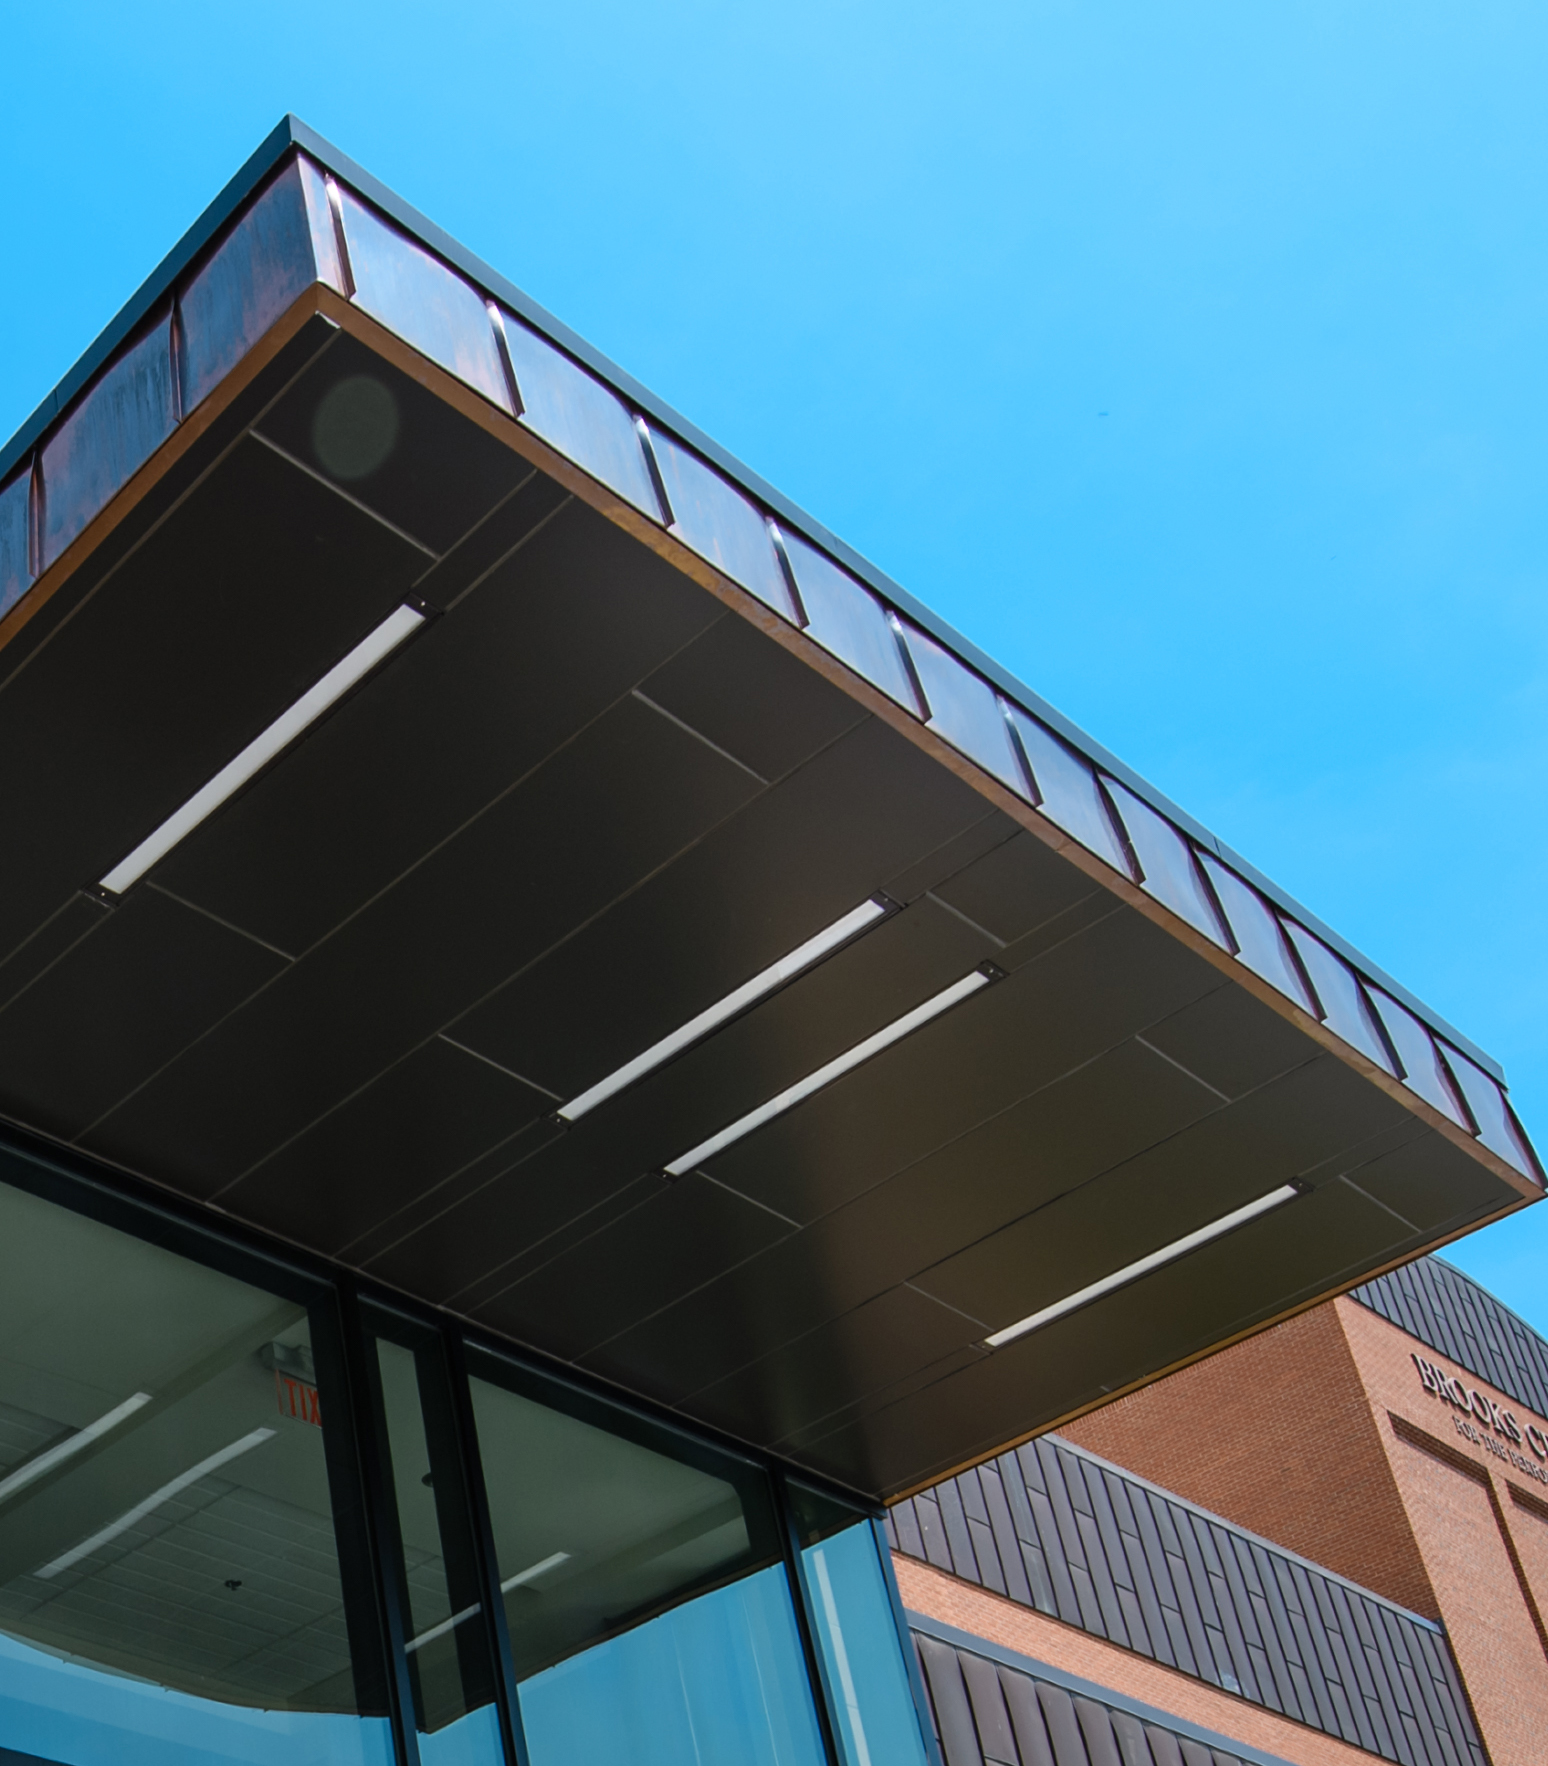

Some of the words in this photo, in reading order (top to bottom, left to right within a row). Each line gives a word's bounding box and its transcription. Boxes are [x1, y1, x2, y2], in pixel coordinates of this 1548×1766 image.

[1410, 1353, 1522, 1445] BROOKS
[1452, 1415, 1481, 1446] FOR
[1479, 1433, 1508, 1462] THE
